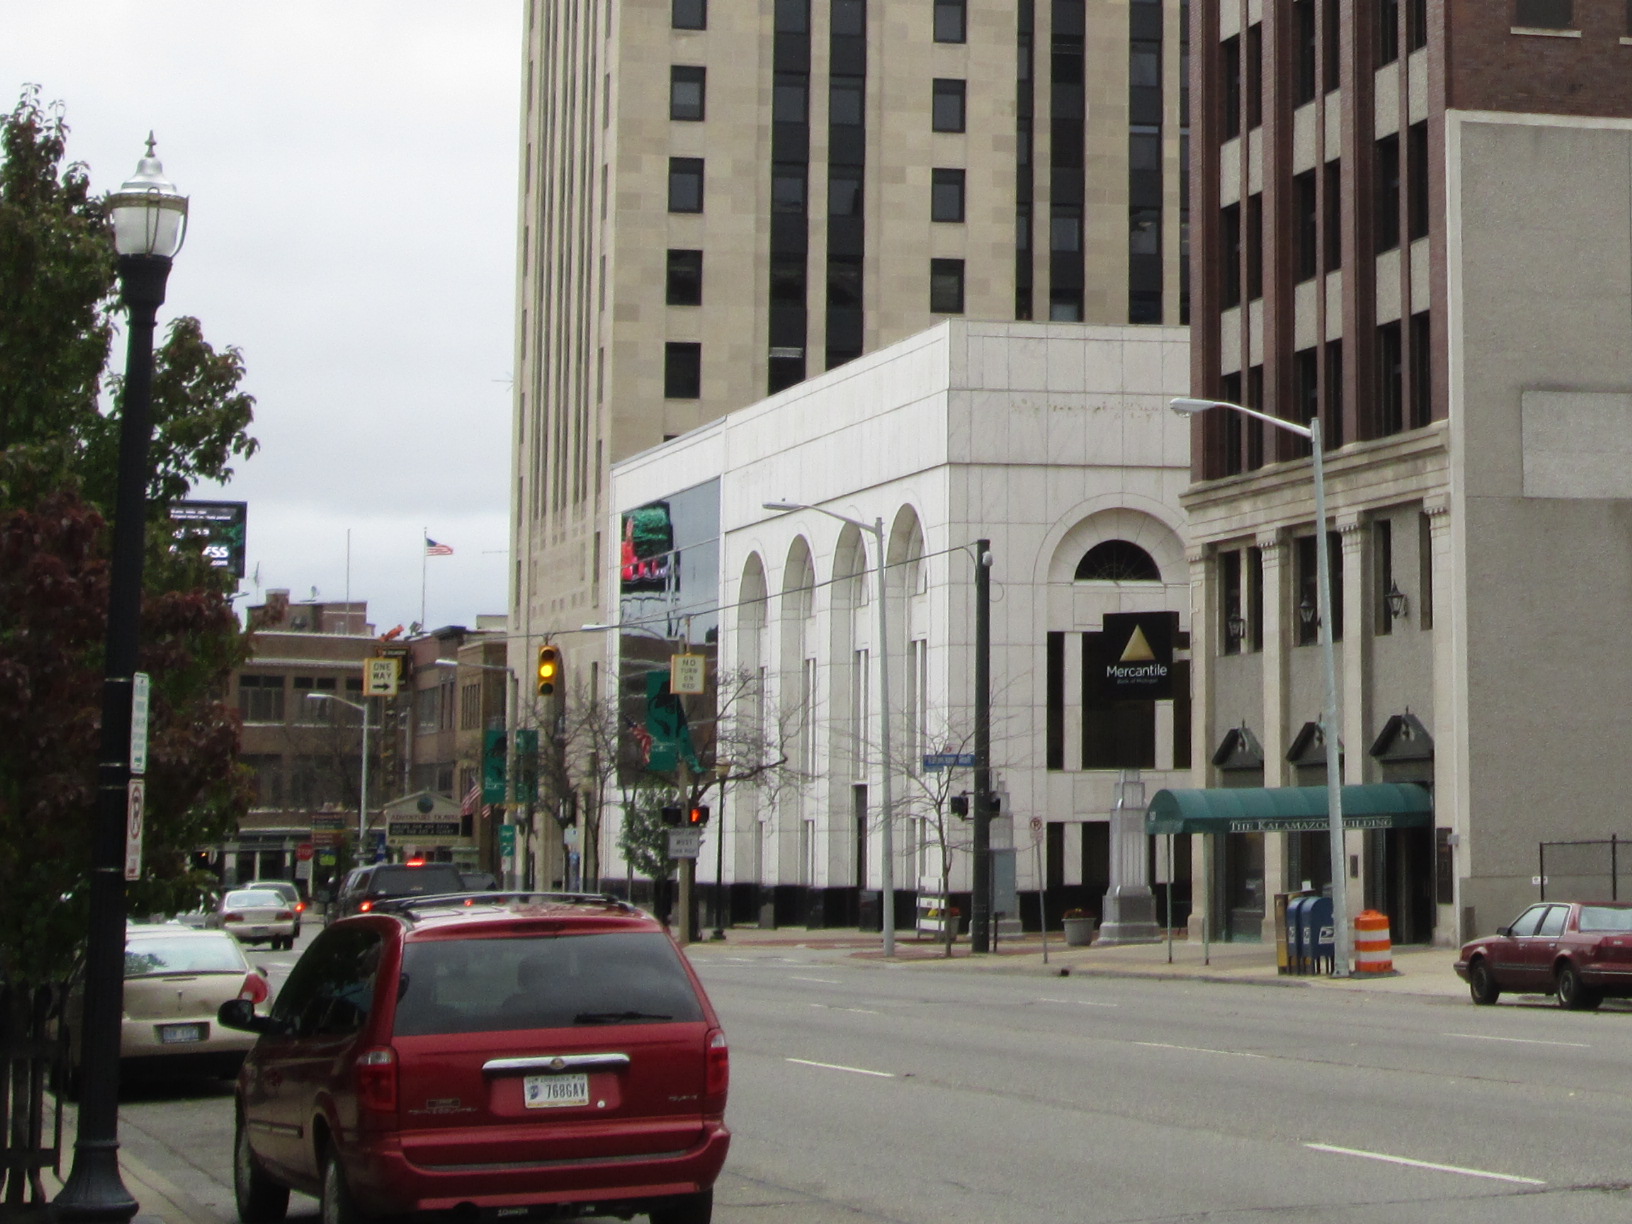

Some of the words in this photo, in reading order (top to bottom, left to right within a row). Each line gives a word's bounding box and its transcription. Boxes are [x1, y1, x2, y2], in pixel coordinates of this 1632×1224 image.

[373, 662, 392, 672] ONE
[682, 659, 697, 667] NO
[1106, 663, 1168, 678] Mercantile
[373, 672, 392, 680] WAY
[1343, 818, 1392, 829] UILDING
